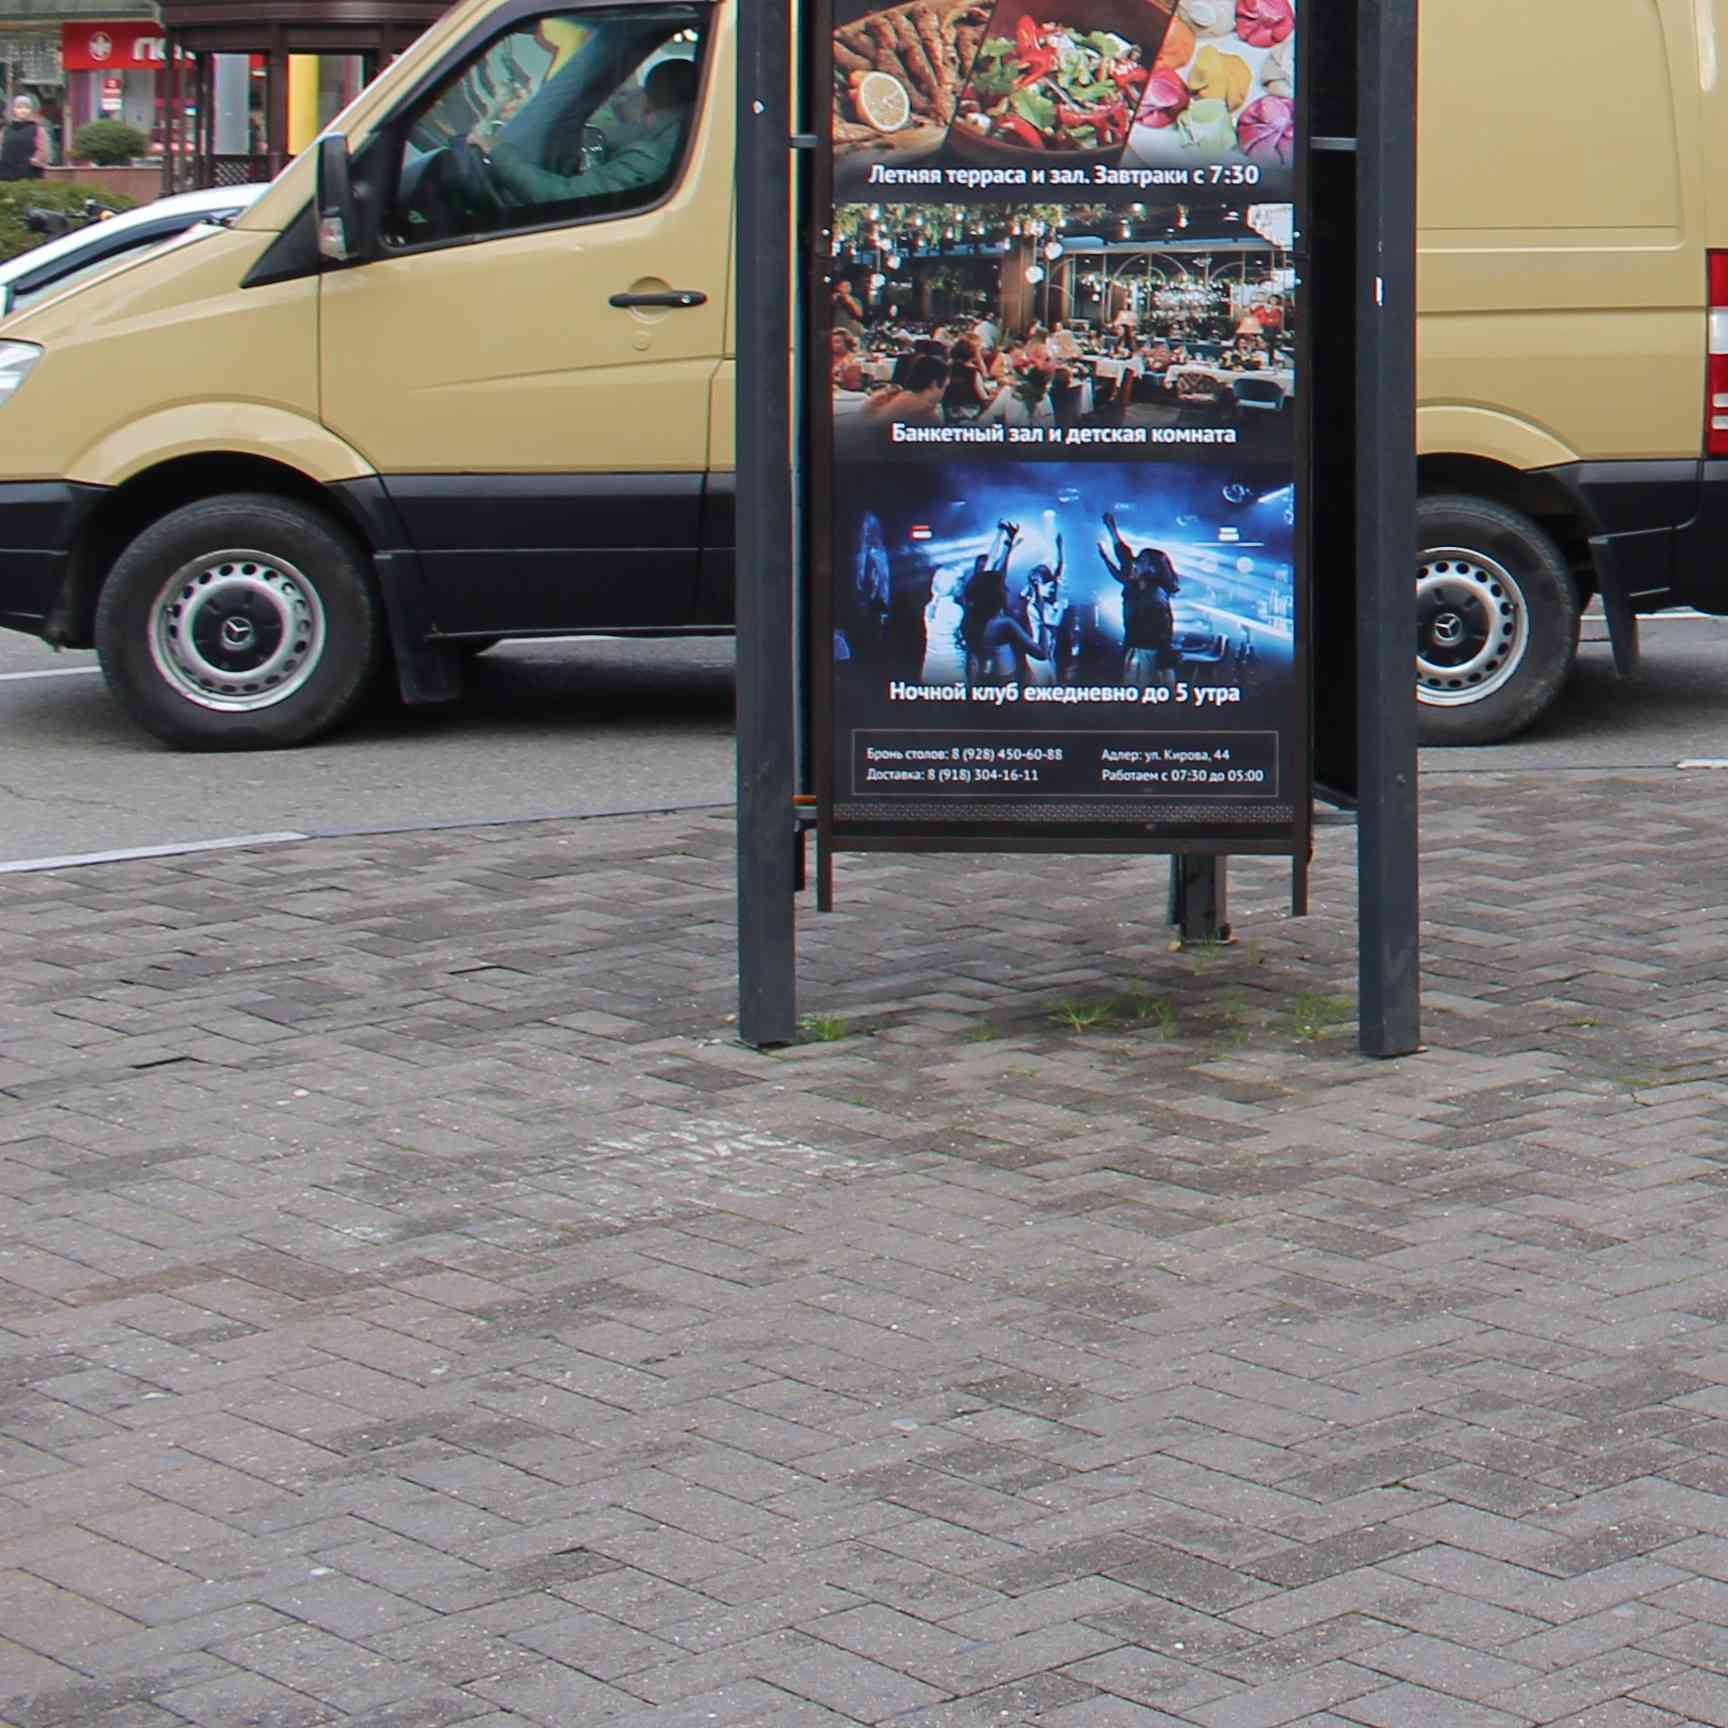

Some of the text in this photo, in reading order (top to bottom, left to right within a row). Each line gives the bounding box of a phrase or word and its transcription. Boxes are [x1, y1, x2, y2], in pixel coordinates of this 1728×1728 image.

[868, 164, 1260, 189] Летняя терраса и зал. Завтраки с 7:30
[891, 422, 1236, 445] Банкетный зал и детская комната
[889, 682, 1241, 707] Ночной клуб ежедневно до 5 утра
[866, 746, 1064, 763] Бронь столов: 8 (928) 450-60-88
[1101, 748, 1231, 763] Адлер: ул. Кирова, 44
[866, 768, 1039, 783] Доставка: 8 (918) 304-16-11
[1101, 769, 1264, 783] Работаем с 07:30 до 05:00
